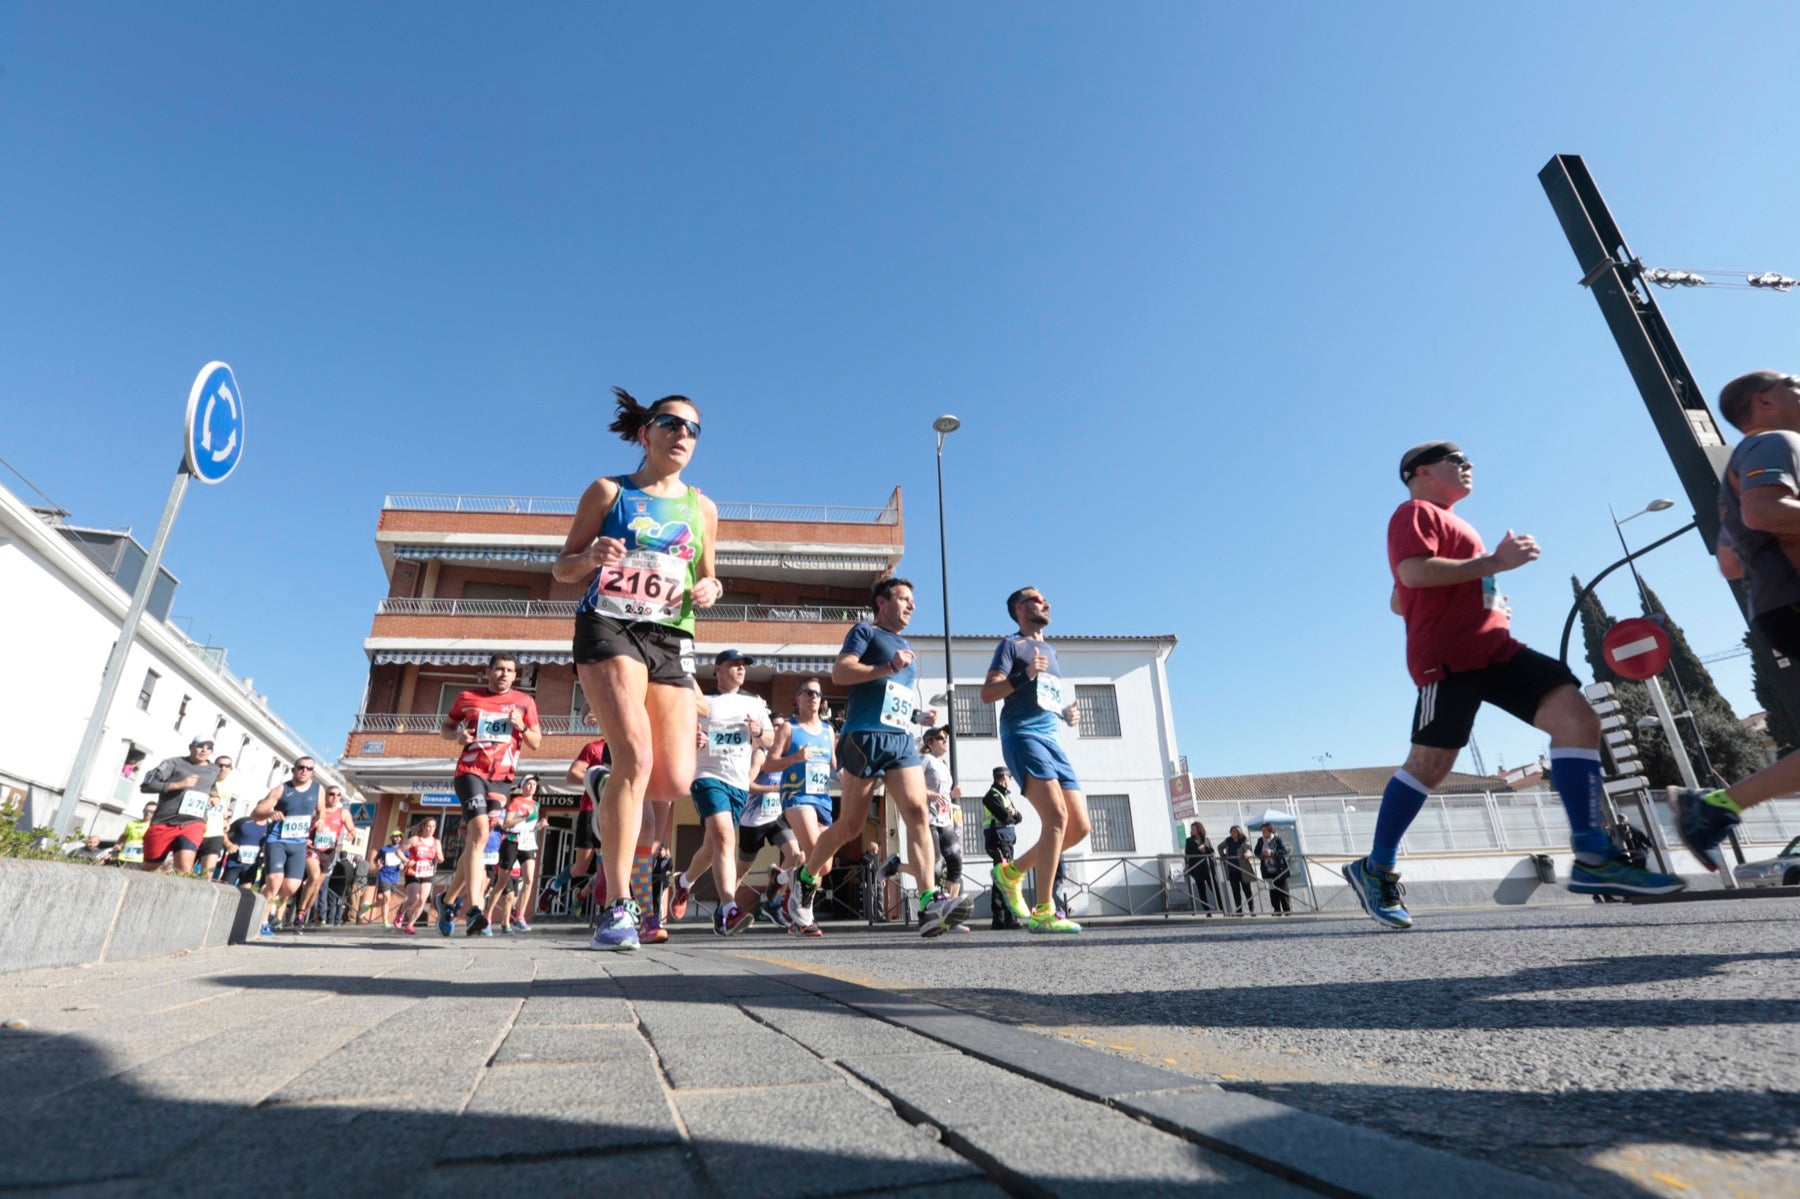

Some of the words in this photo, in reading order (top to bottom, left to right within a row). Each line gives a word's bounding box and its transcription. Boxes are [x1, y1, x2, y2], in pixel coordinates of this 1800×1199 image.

[604, 570, 680, 602] 2167
[484, 721, 508, 733] 761
[715, 732, 742, 745] 276
[411, 781, 455, 792] RESTA
[423, 795, 452, 803] Granada
[534, 796, 575, 806] HITOS
[284, 822, 310, 833] 1055
